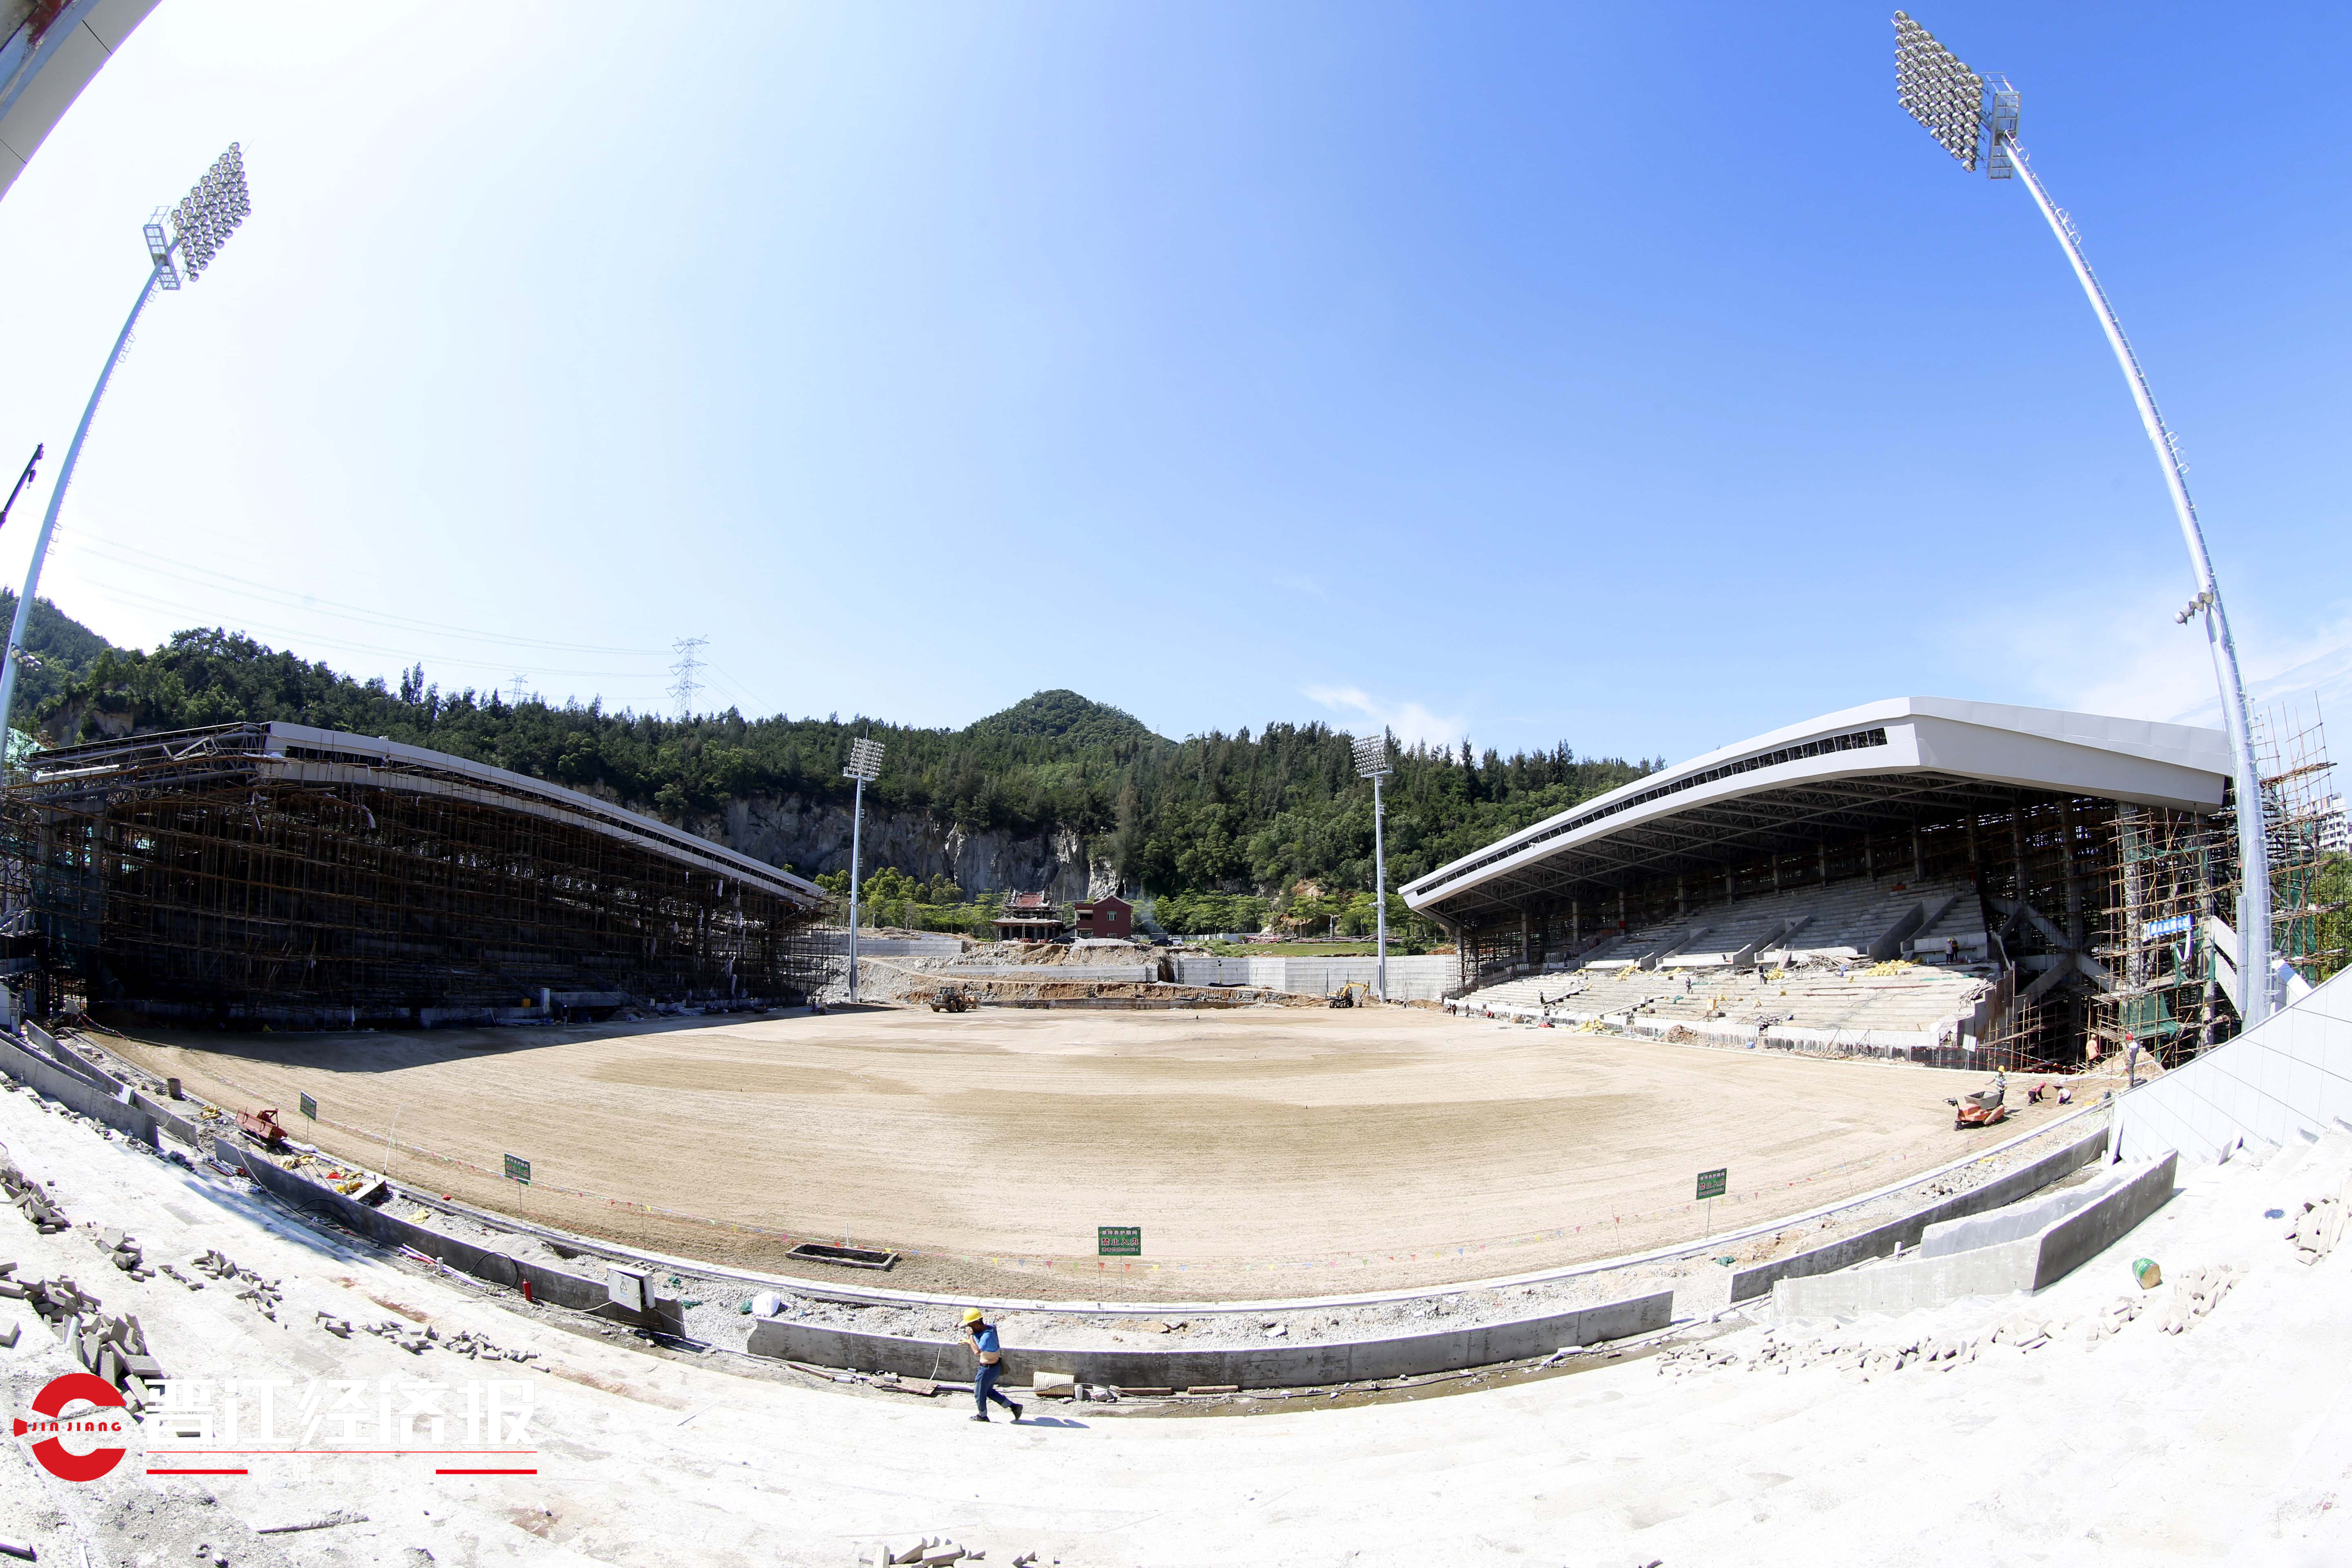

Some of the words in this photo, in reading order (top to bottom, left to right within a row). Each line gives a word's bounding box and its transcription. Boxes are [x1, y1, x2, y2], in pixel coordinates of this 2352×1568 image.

[1699, 1179, 1725, 1190] 禁止入内
[1101, 1238, 1138, 1246] 禁止入内
